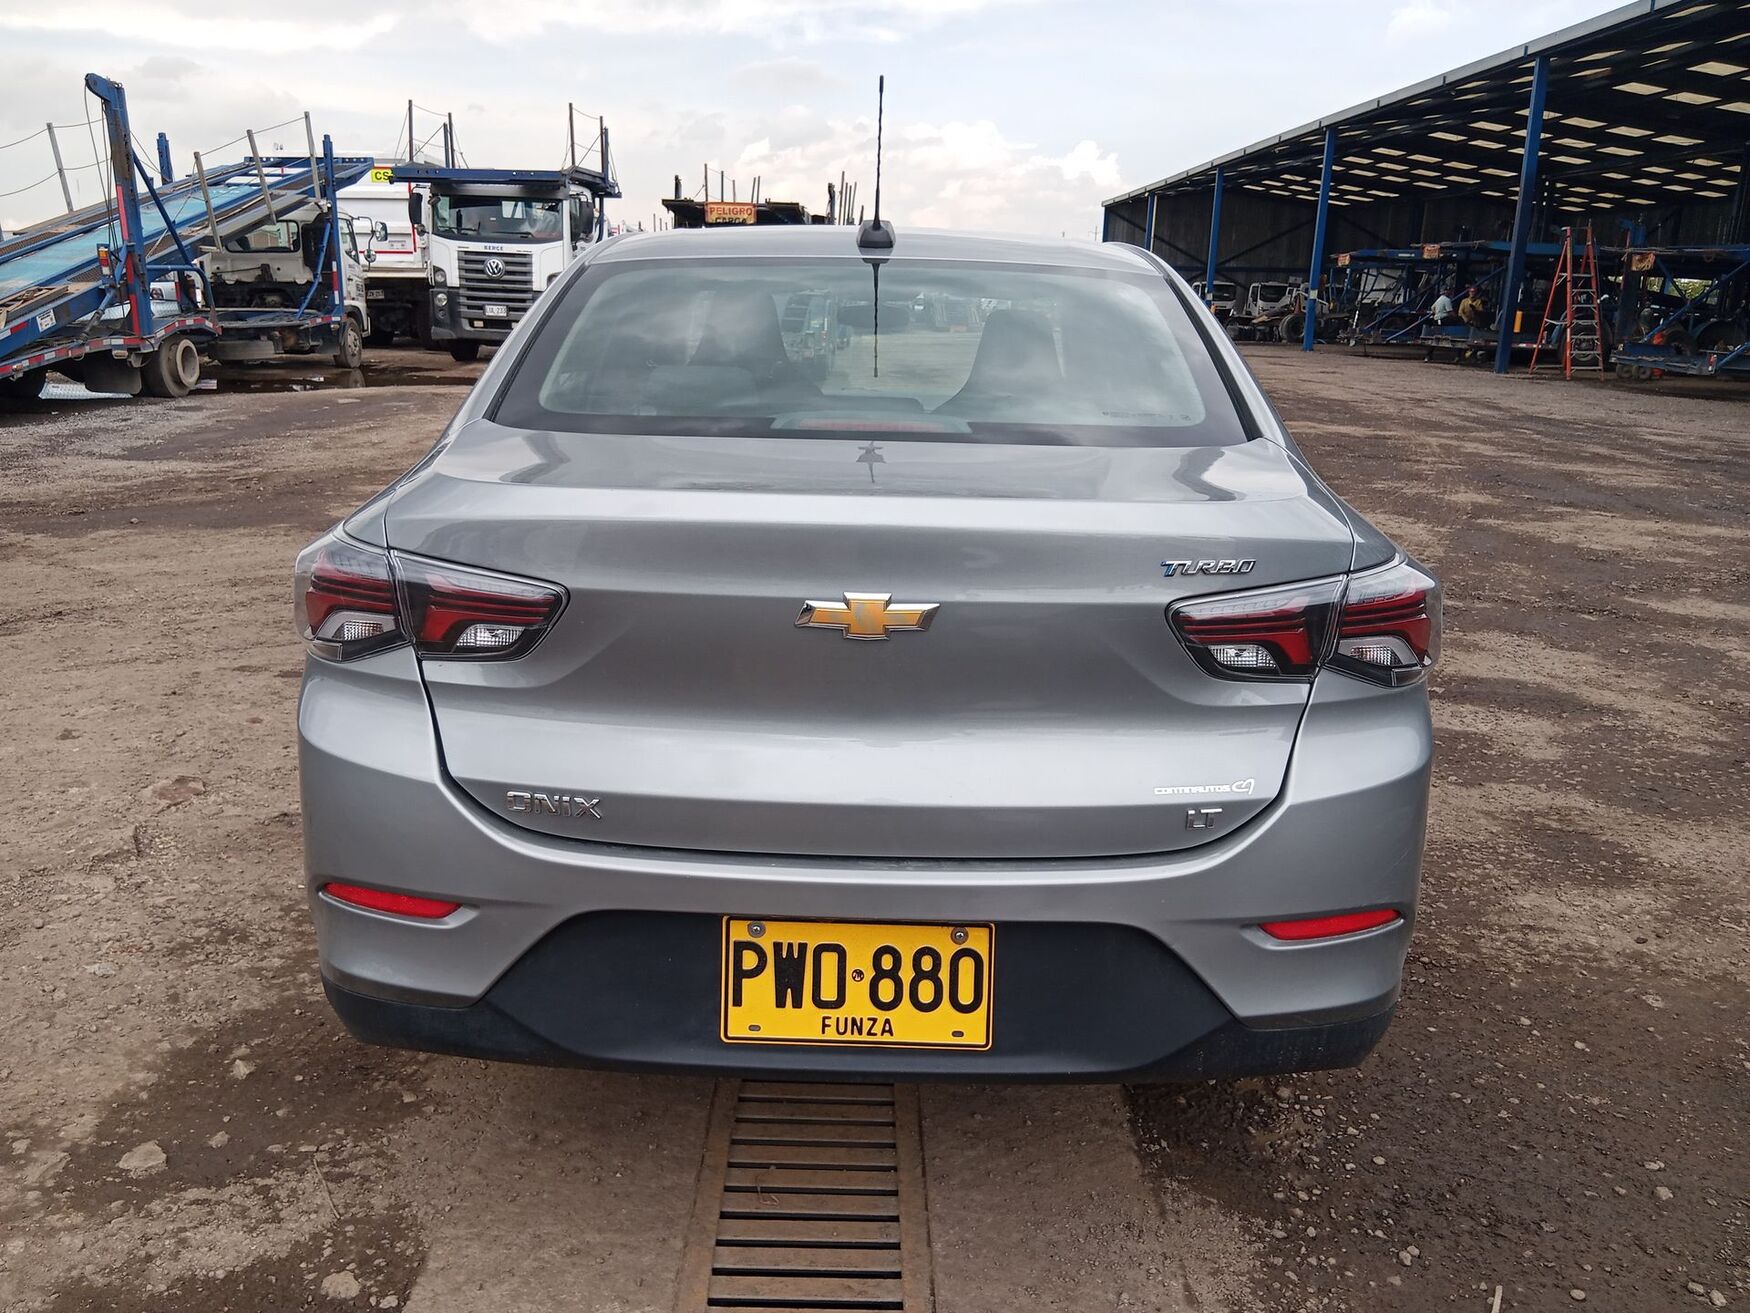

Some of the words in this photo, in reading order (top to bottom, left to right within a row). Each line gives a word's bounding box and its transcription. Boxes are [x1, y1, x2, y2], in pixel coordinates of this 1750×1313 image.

[709, 206, 753, 216] PELIGRO
[1160, 559, 1257, 577] TURBO
[505, 790, 603, 819] ONIX
[1185, 807, 1223, 830] LT
[820, 1015, 895, 1037] FUNZA
